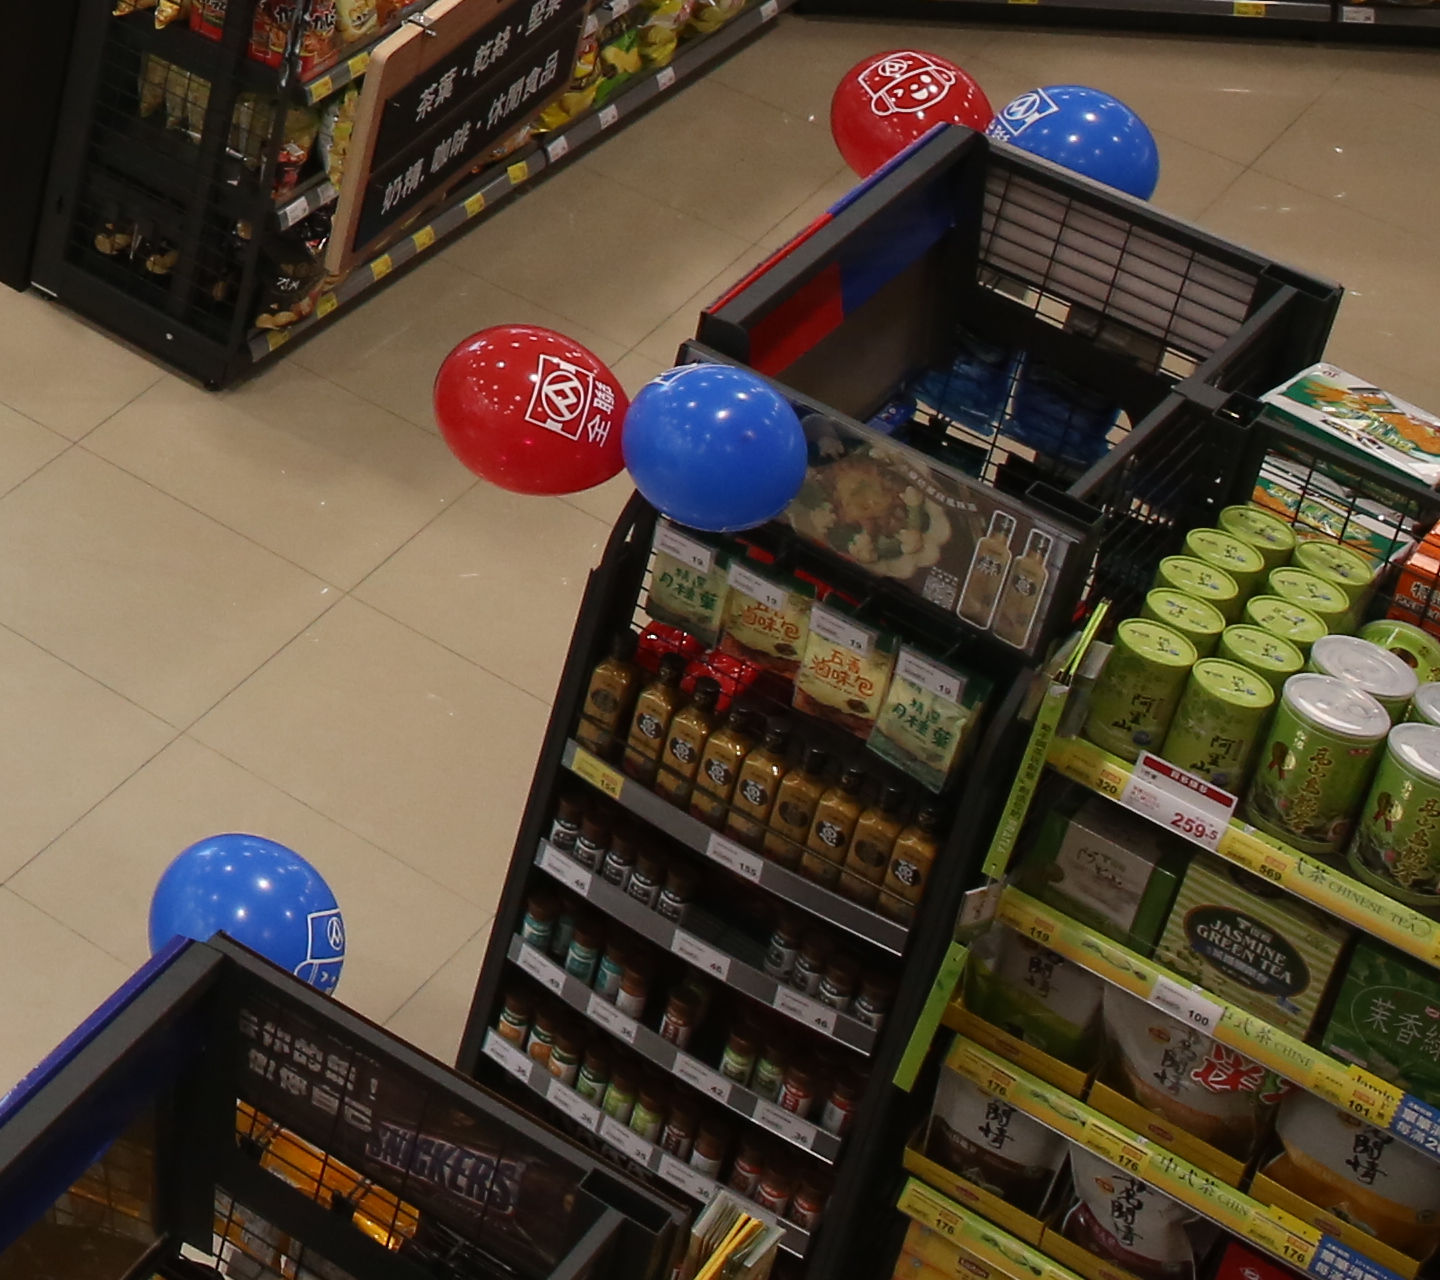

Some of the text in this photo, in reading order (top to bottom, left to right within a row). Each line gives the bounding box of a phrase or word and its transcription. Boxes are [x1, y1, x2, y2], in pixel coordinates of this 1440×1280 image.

[1095, 779, 1118, 795] 320
[1259, 863, 1283, 883] 569
[1328, 882, 1387, 919] CHINESE
[1210, 916, 1289, 965] JASMINE
[1196, 924, 1293, 987] GREEN TEA
[1188, 1008, 1211, 1028] 100
[1117, 1153, 1141, 1173] 176
[1281, 1242, 1307, 1264] 176
